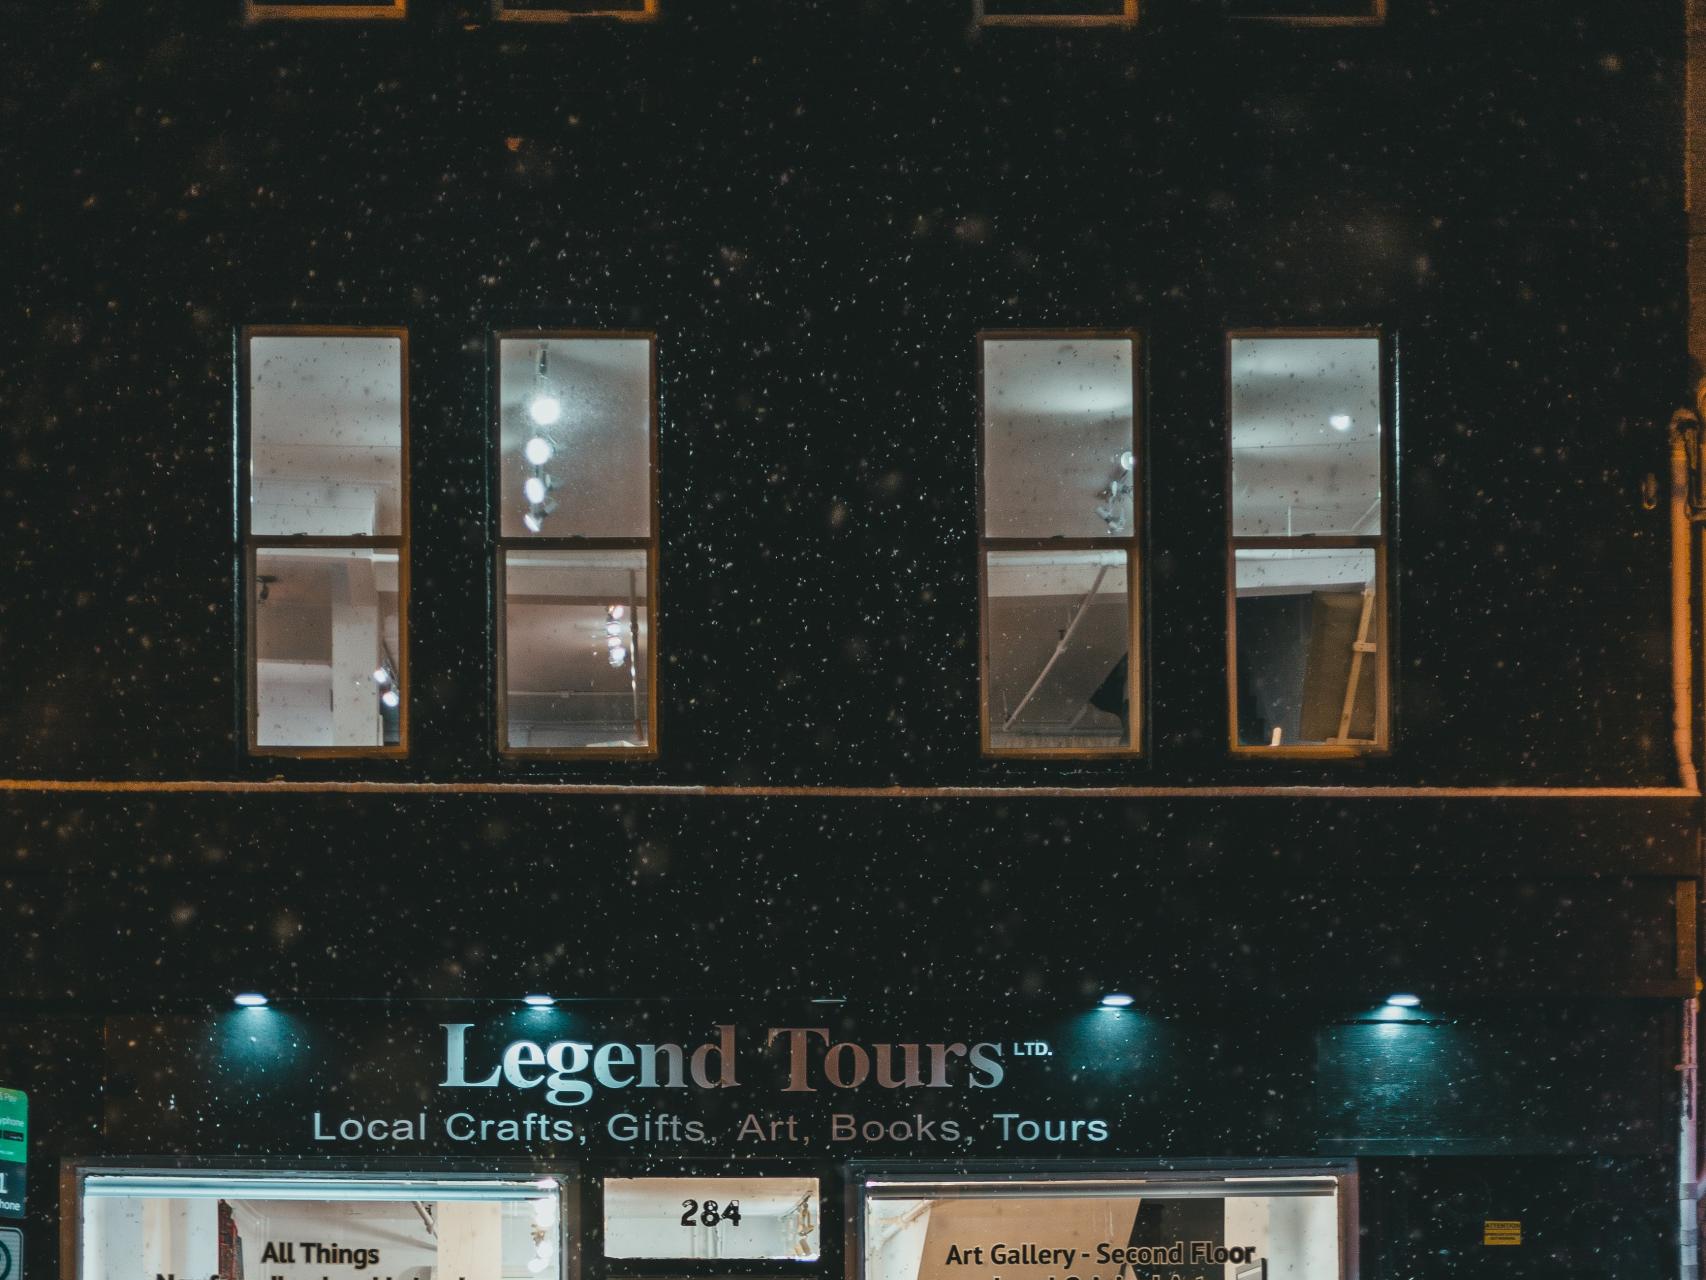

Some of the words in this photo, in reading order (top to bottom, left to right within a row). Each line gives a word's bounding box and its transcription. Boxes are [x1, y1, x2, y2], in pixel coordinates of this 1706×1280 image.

[1013, 1042, 1053, 1057] LTD.
[440, 1023, 741, 1105] Legend
[768, 1026, 1004, 1092] Tours
[312, 1112, 426, 1141] Local
[445, 1111, 588, 1147] Crafts,
[606, 1113, 718, 1147] Gifts,
[736, 1114, 811, 1146] Art,
[832, 1114, 973, 1146] Books,
[994, 1114, 1109, 1143] Tours
[681, 1199, 741, 1227] 284
[261, 1242, 295, 1264] All
[301, 1242, 379, 1269] Things
[946, 1244, 983, 1265] Art
[990, 1243, 1076, 1269] Gallery
[1096, 1241, 1184, 1265] Second
[1190, 1241, 1255, 1264] Floor
